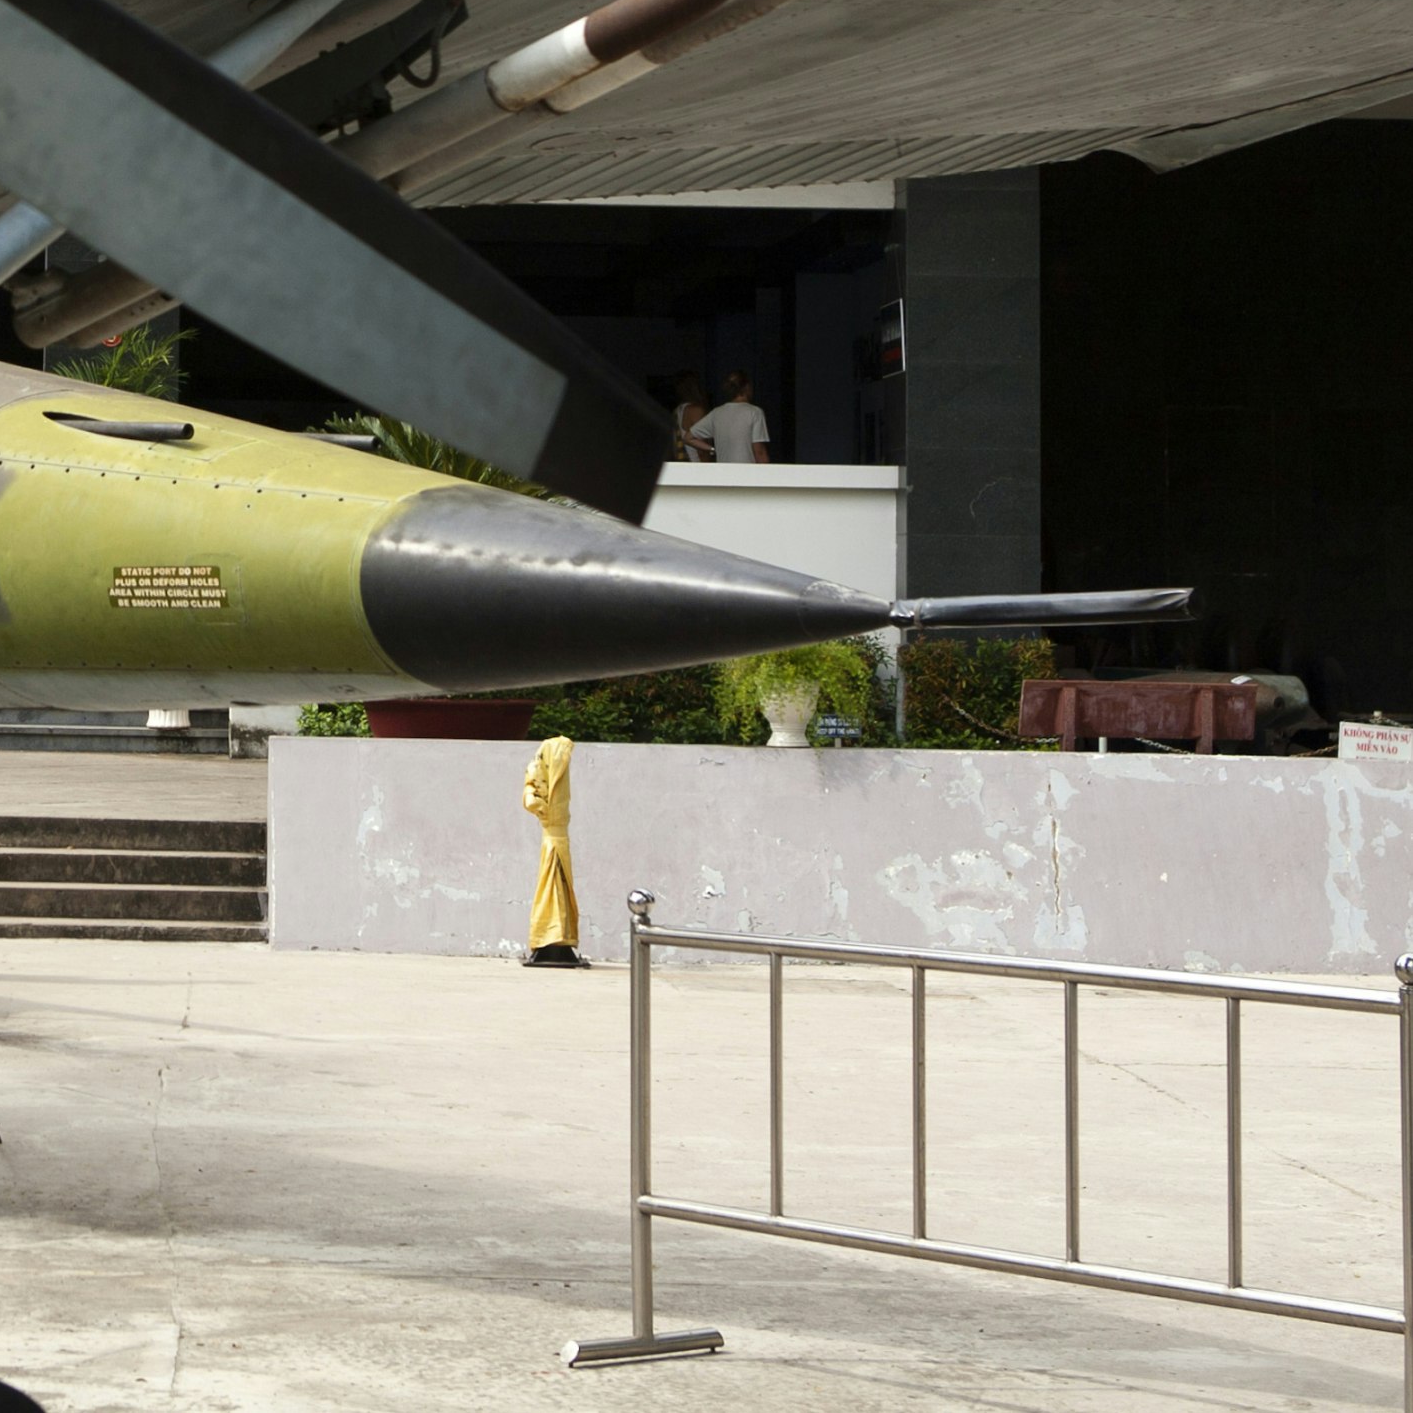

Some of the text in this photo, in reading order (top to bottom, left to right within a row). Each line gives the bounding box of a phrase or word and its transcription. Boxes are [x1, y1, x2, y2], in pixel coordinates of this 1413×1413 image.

[121, 568, 212, 576] STATIC PORT DO NOT
[138, 578, 151, 587] OR
[152, 578, 189, 587] DEFORM
[190, 578, 219, 587] HOLES
[109, 588, 227, 597] AREA WITHIN CIRCLE MUST
[118, 599, 221, 608] BE SMOOTH AND CLEAN
